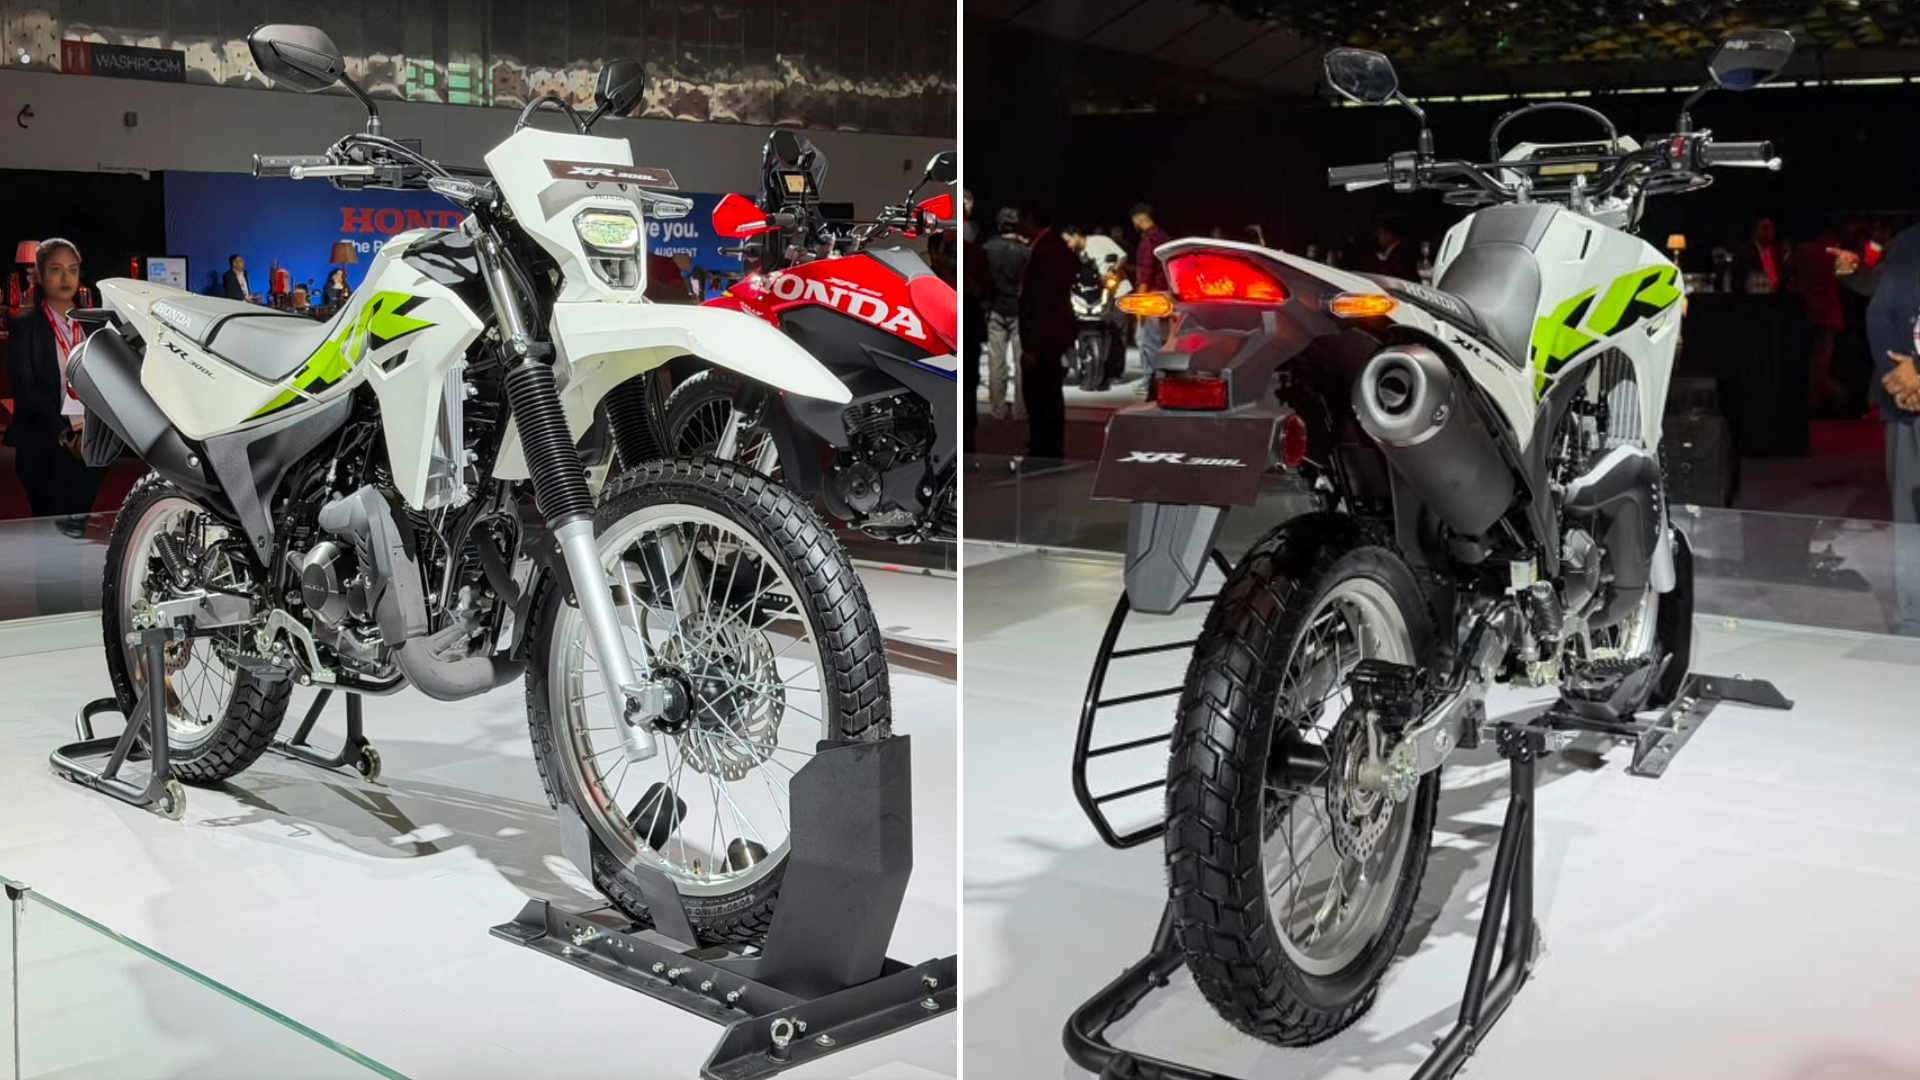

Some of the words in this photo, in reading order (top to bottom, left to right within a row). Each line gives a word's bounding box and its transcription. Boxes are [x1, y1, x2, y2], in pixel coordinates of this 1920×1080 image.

[96, 53, 180, 72] WASHROOM
[566, 165, 616, 178] XR
[617, 171, 659, 182] 300L
[662, 221, 699, 243] you.
[1402, 281, 1461, 314] HONDA
[157, 303, 192, 327] HONDA
[163, 341, 189, 361] XR
[187, 360, 216, 380] 300L
[1116, 451, 1186, 464] XR
[1184, 457, 1247, 466] 300L
